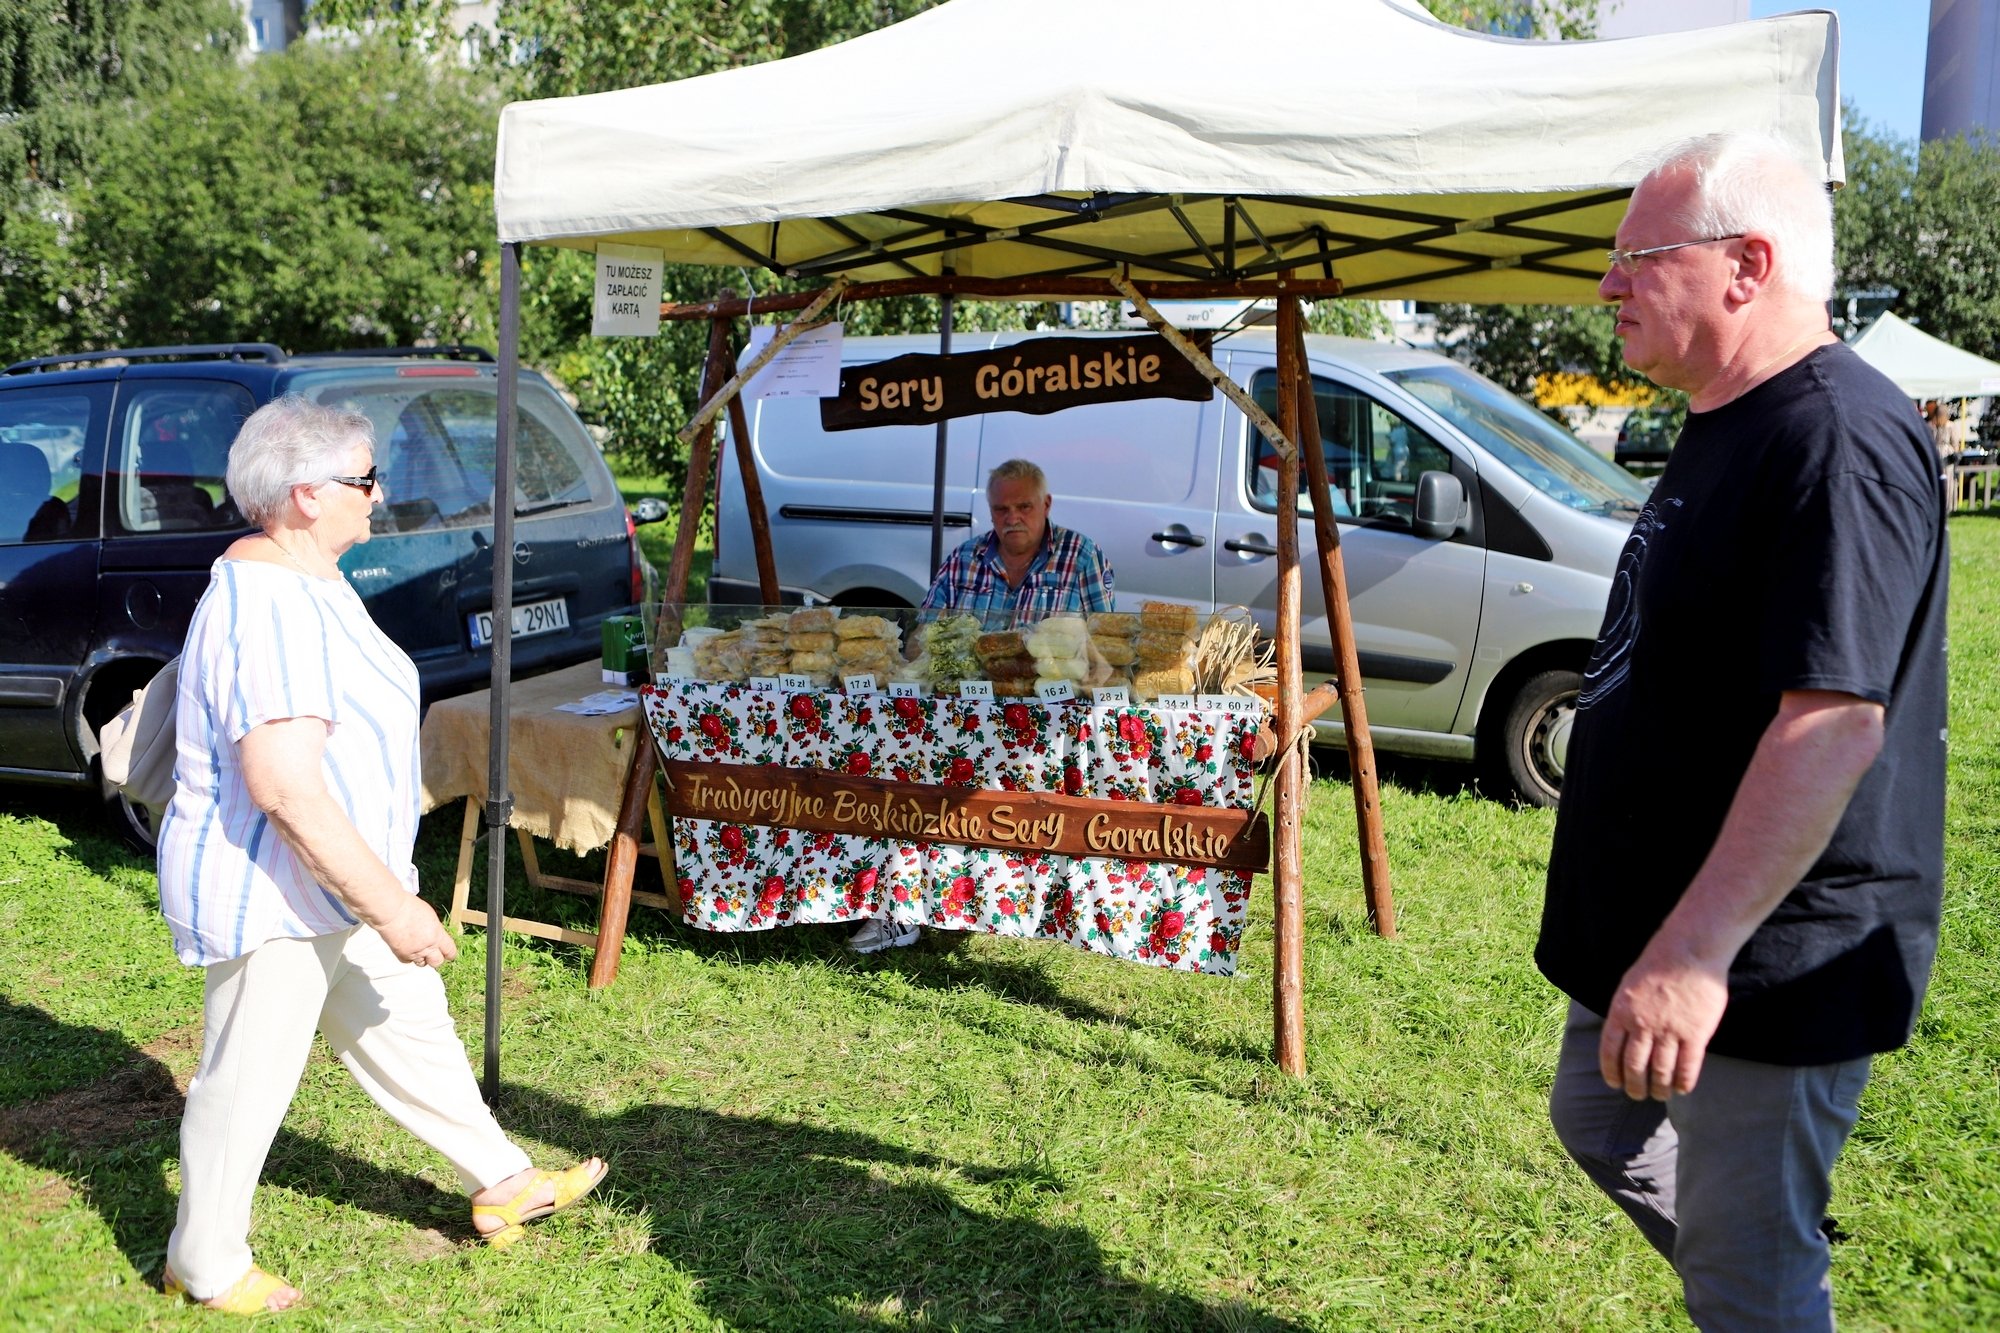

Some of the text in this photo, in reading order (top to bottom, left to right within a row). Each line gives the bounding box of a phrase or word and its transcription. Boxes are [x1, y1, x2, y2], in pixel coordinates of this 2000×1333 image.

[606, 264, 652, 280] TU MOŻESZ
[607, 283, 647, 297] ZAPŁACIĆ
[612, 302, 640, 318] KARTĄ
[859, 346, 1161, 412] Sery Góralskie
[352, 566, 392, 579] OPEL
[480, 601, 564, 641] DL 29N1
[757, 682, 773, 691] 3 zł
[785, 679, 795, 687] 16
[850, 679, 871, 689] 17 zł
[896, 688, 913, 696] 8 zł
[965, 685, 988, 694] 18 zł
[1044, 685, 1067, 697] 16 zł
[1100, 692, 1123, 702] 28 zł
[1164, 700, 1188, 709] 34 zł
[1206, 700, 1212, 709] 3
[1228, 701, 1253, 711] 60 zł
[685, 773, 1230, 859] Tradycyjne Beskidzkie Sery Goralskie
